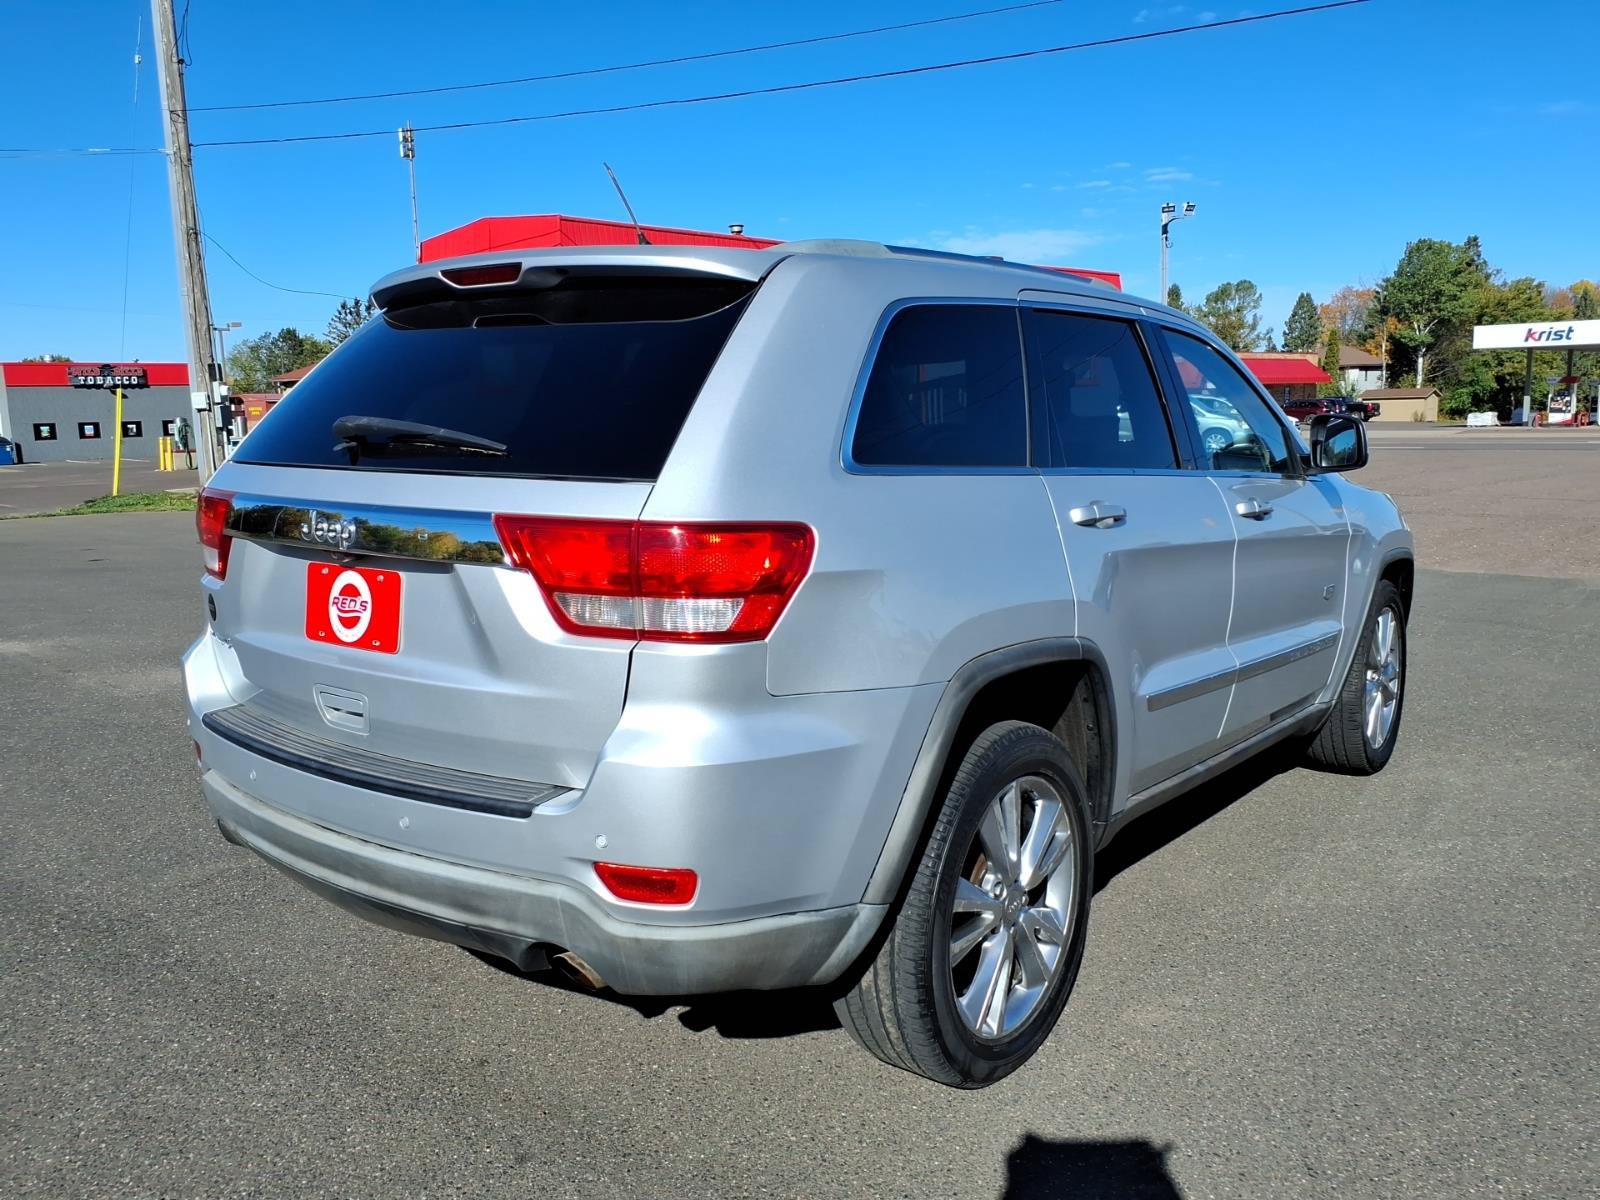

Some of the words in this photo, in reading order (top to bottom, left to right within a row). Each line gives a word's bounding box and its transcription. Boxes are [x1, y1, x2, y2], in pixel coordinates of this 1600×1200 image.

[1524, 326, 1574, 342] krist
[78, 376, 138, 385] TOBACCO
[301, 510, 357, 550] Jeep
